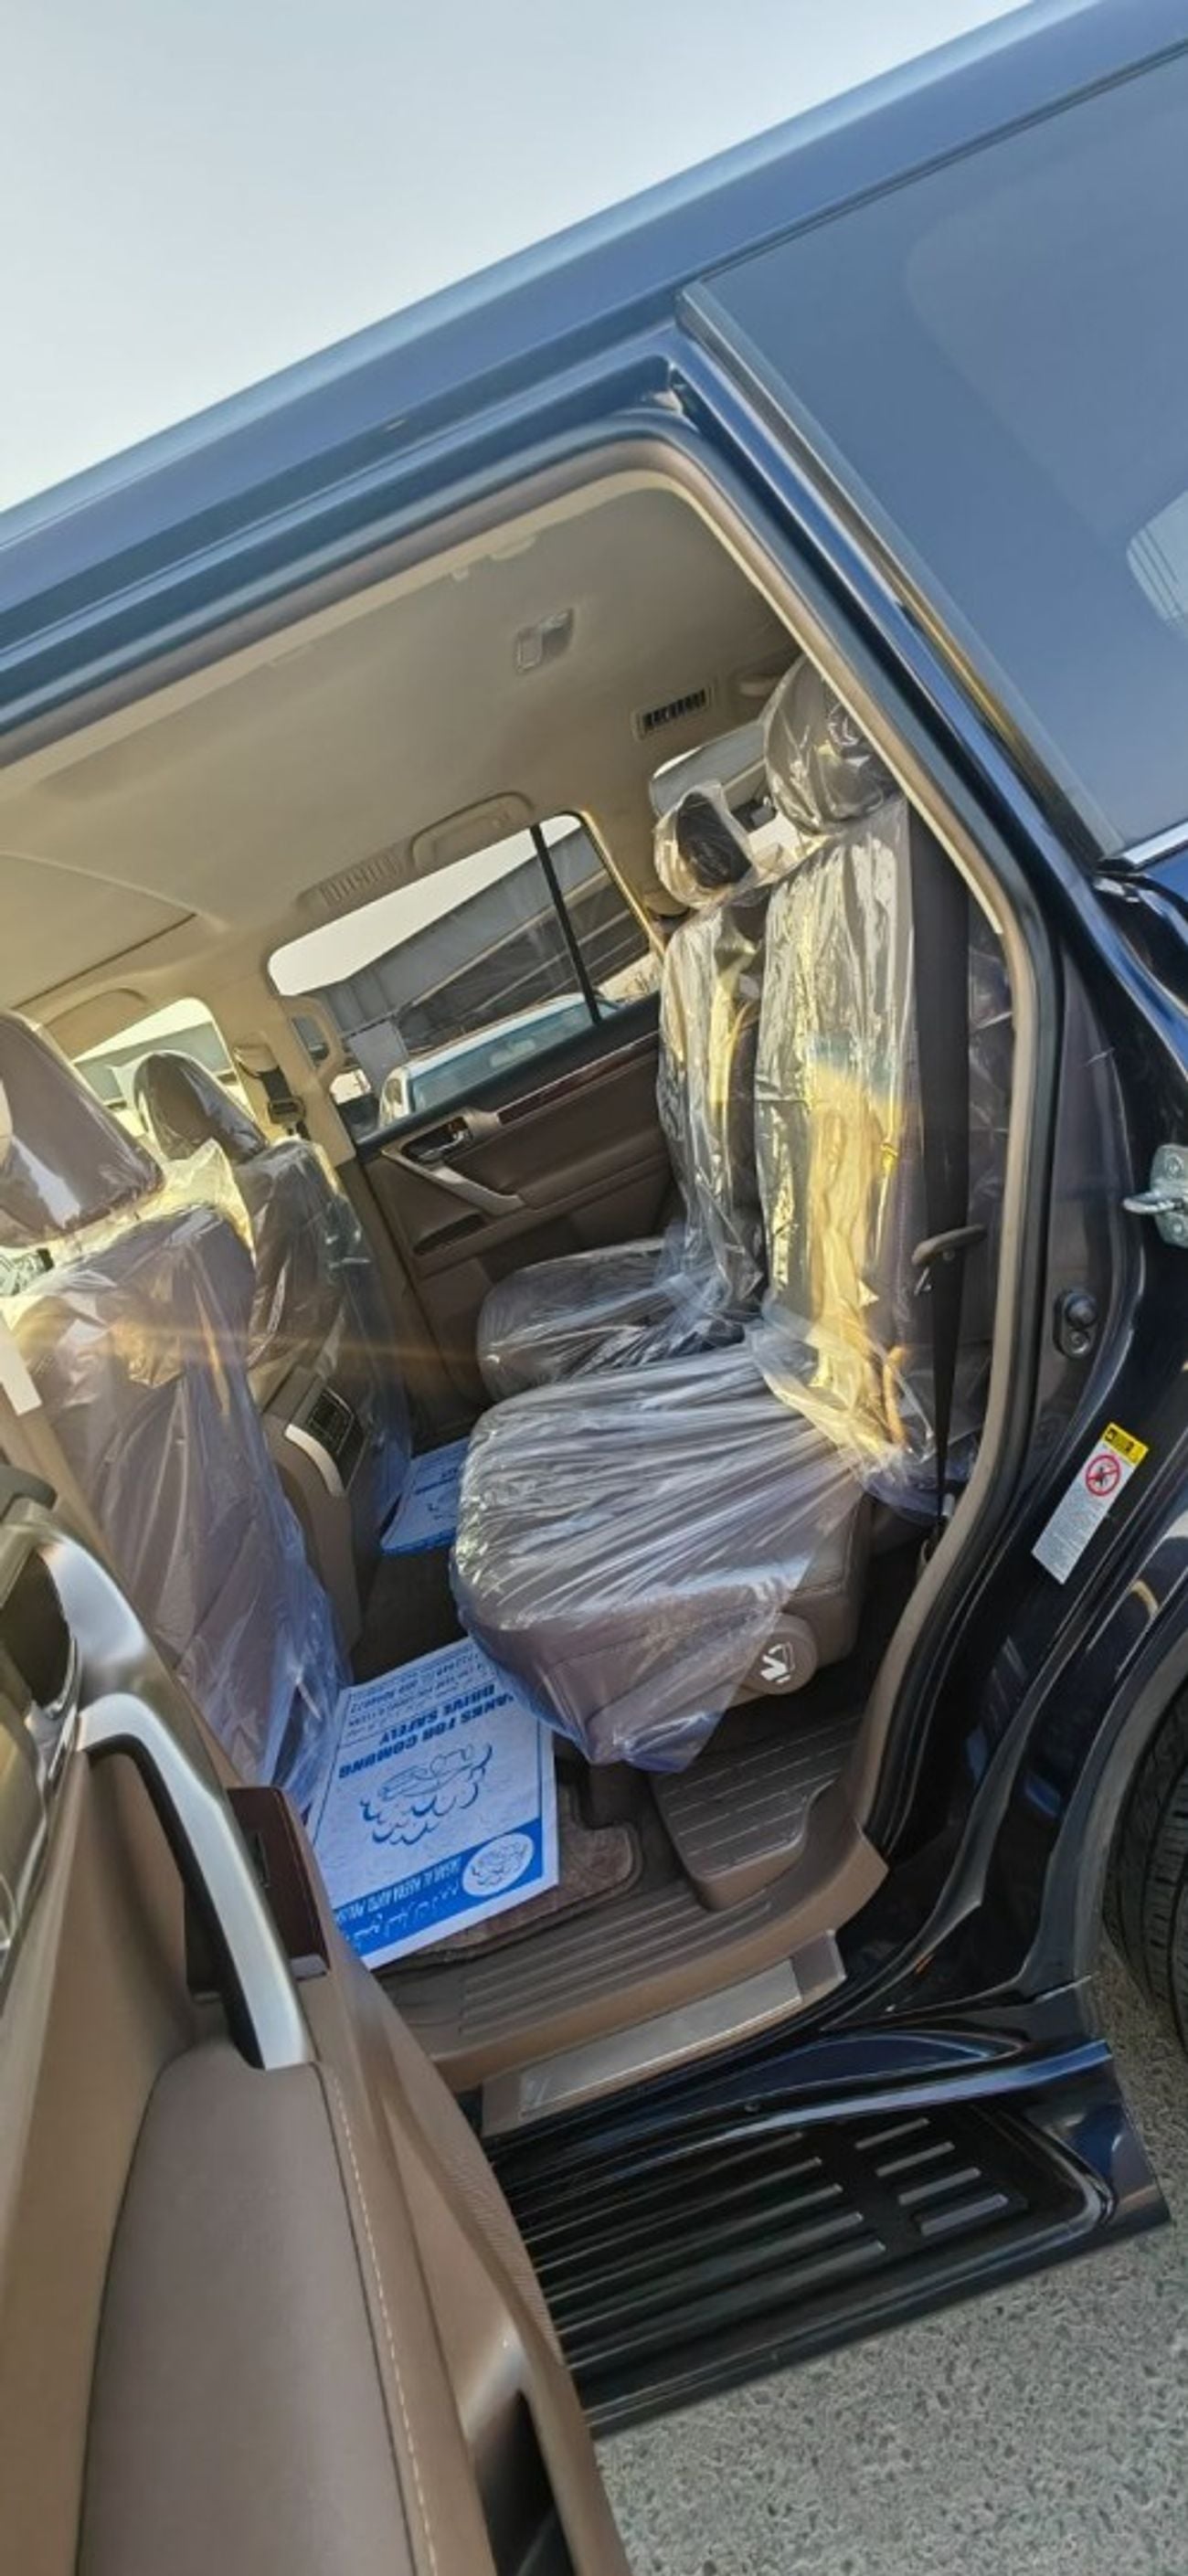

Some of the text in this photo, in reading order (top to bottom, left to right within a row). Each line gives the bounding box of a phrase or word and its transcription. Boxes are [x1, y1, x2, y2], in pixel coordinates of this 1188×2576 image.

[442, 1683, 495, 1716] DRIVE
[379, 1710, 439, 1745] SAFELY
[421, 1717, 456, 1742] FOR
